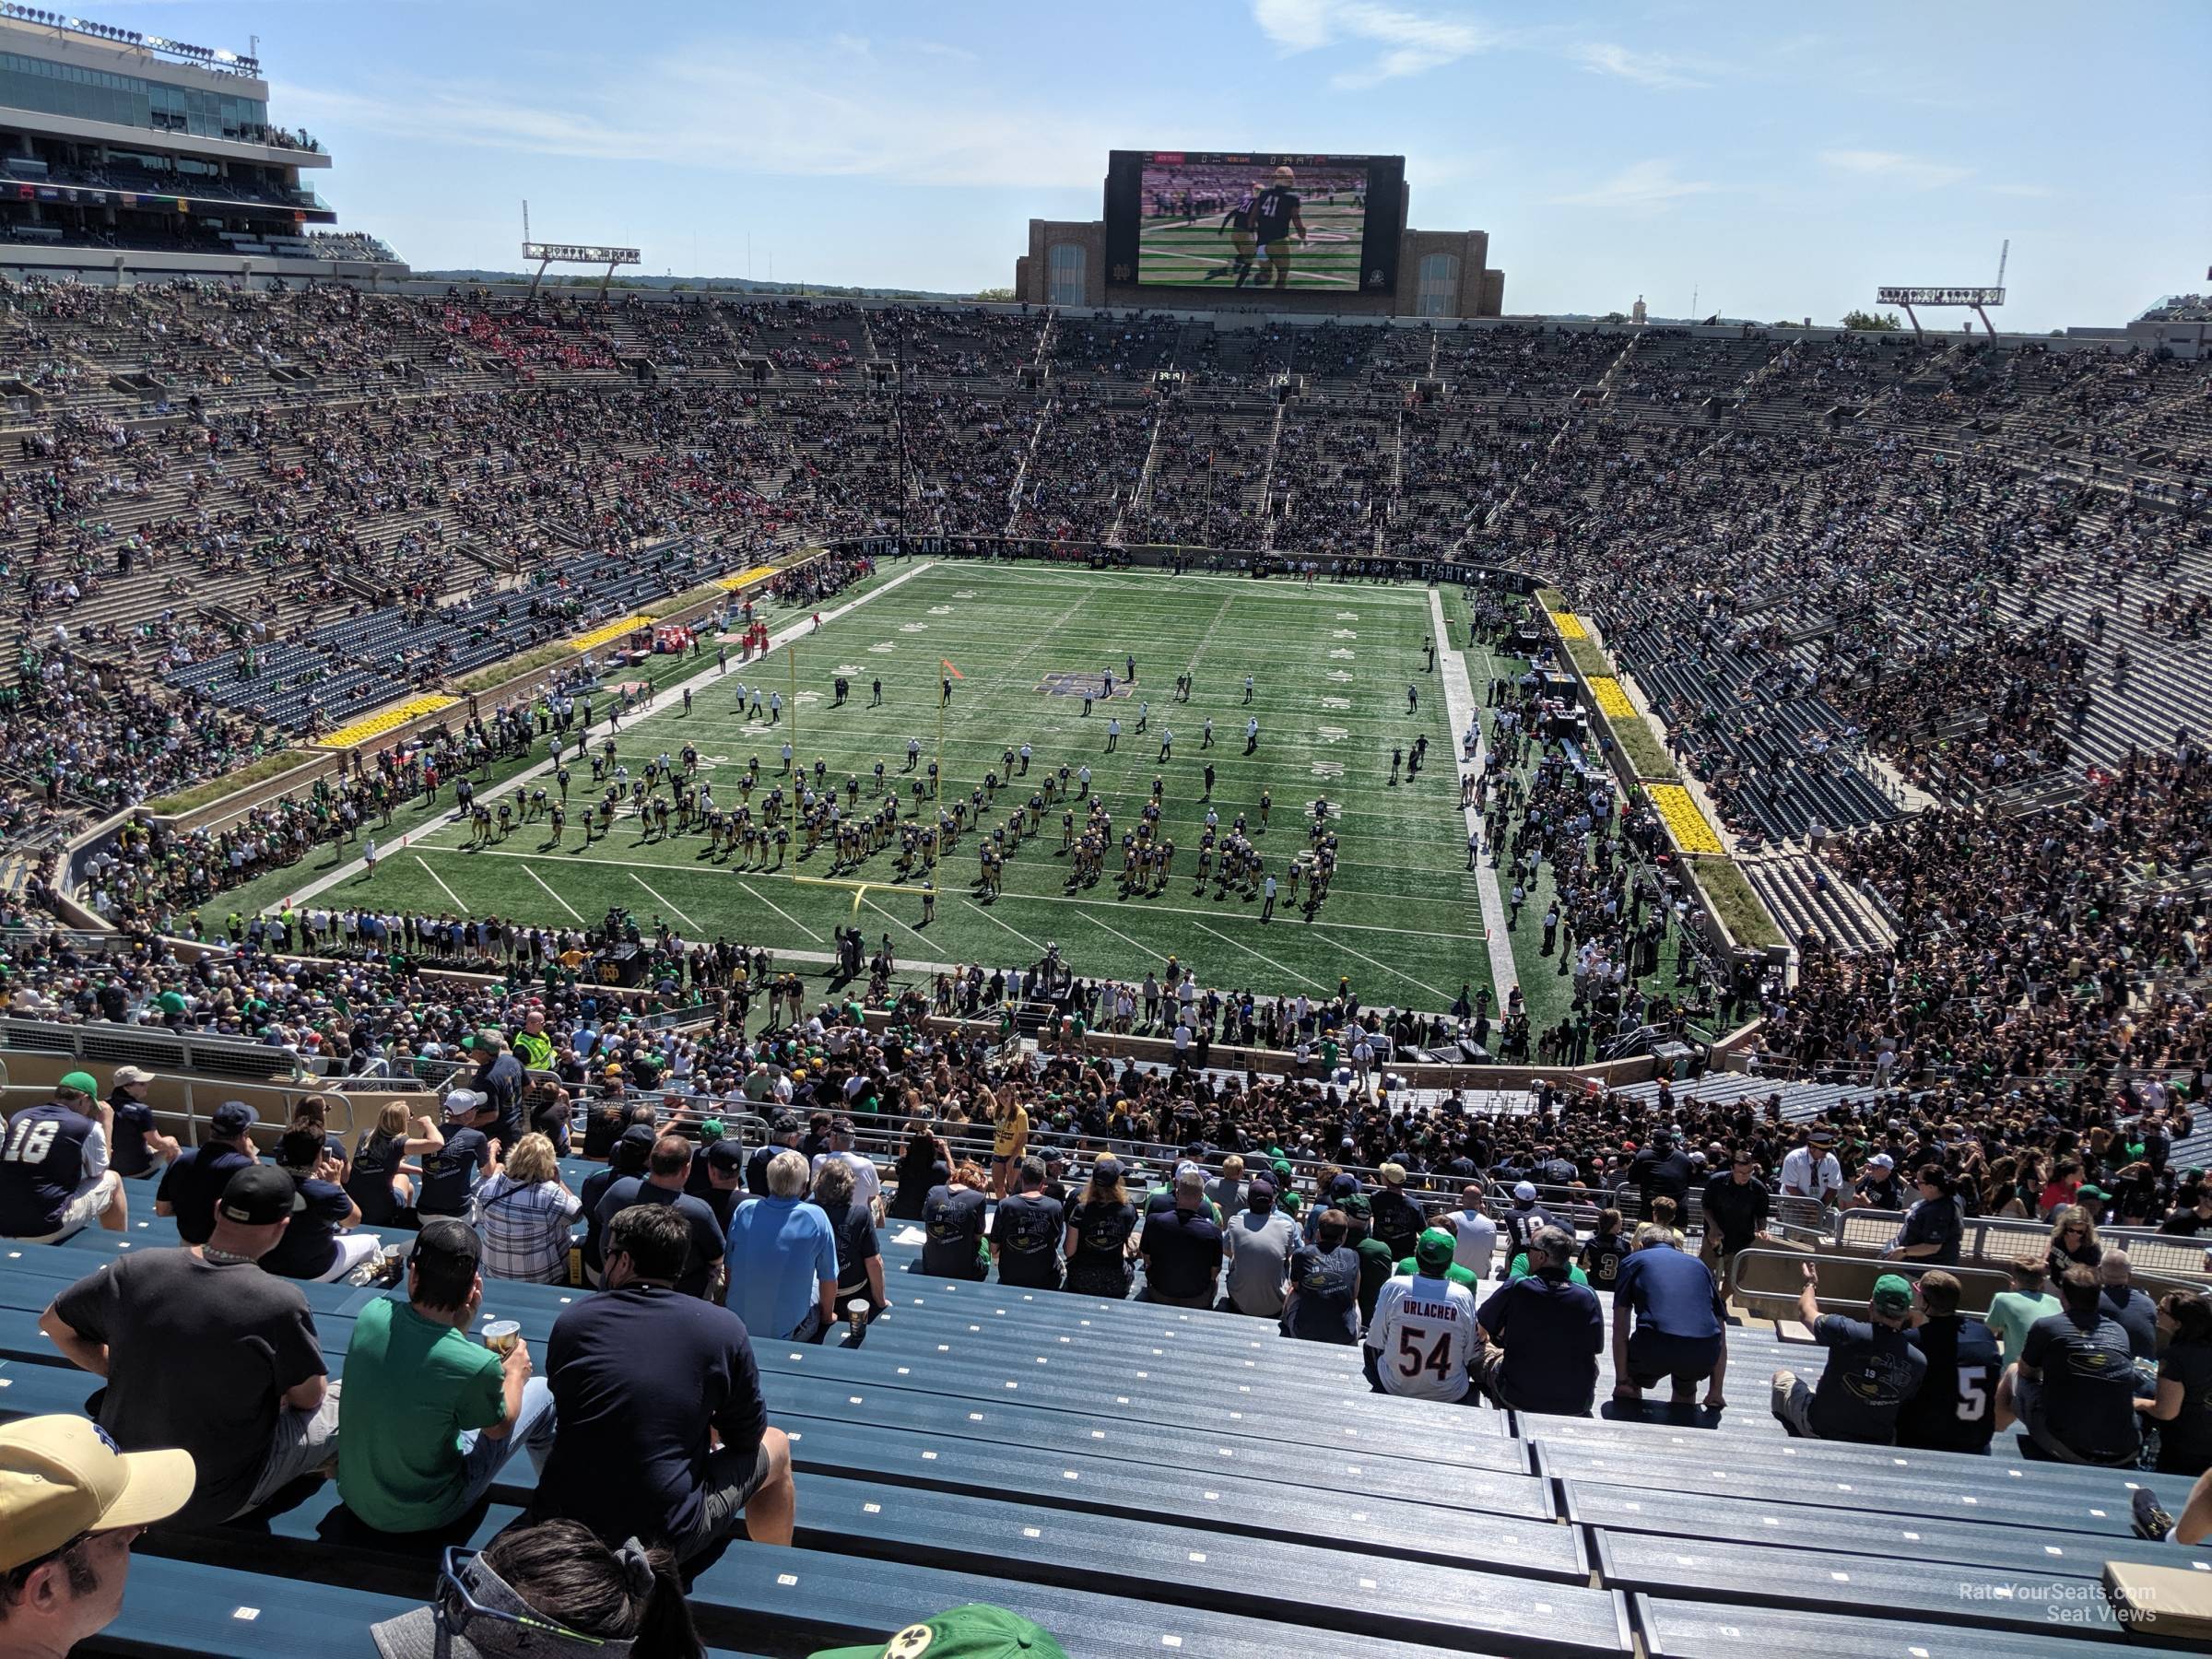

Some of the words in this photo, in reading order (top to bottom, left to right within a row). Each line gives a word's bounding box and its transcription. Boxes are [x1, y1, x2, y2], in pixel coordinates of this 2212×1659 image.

[1262, 195, 1279, 218] 41
[1159, 371, 1181, 381] 39:19
[1278, 376, 1288, 384] 25
[1598, 1253, 1619, 1280] 3
[1403, 1300, 1458, 1322] URLACHER
[1398, 1325, 1452, 1382] 54
[1864, 1368, 1877, 1379] 19
[1956, 1365, 1987, 1421] 5
